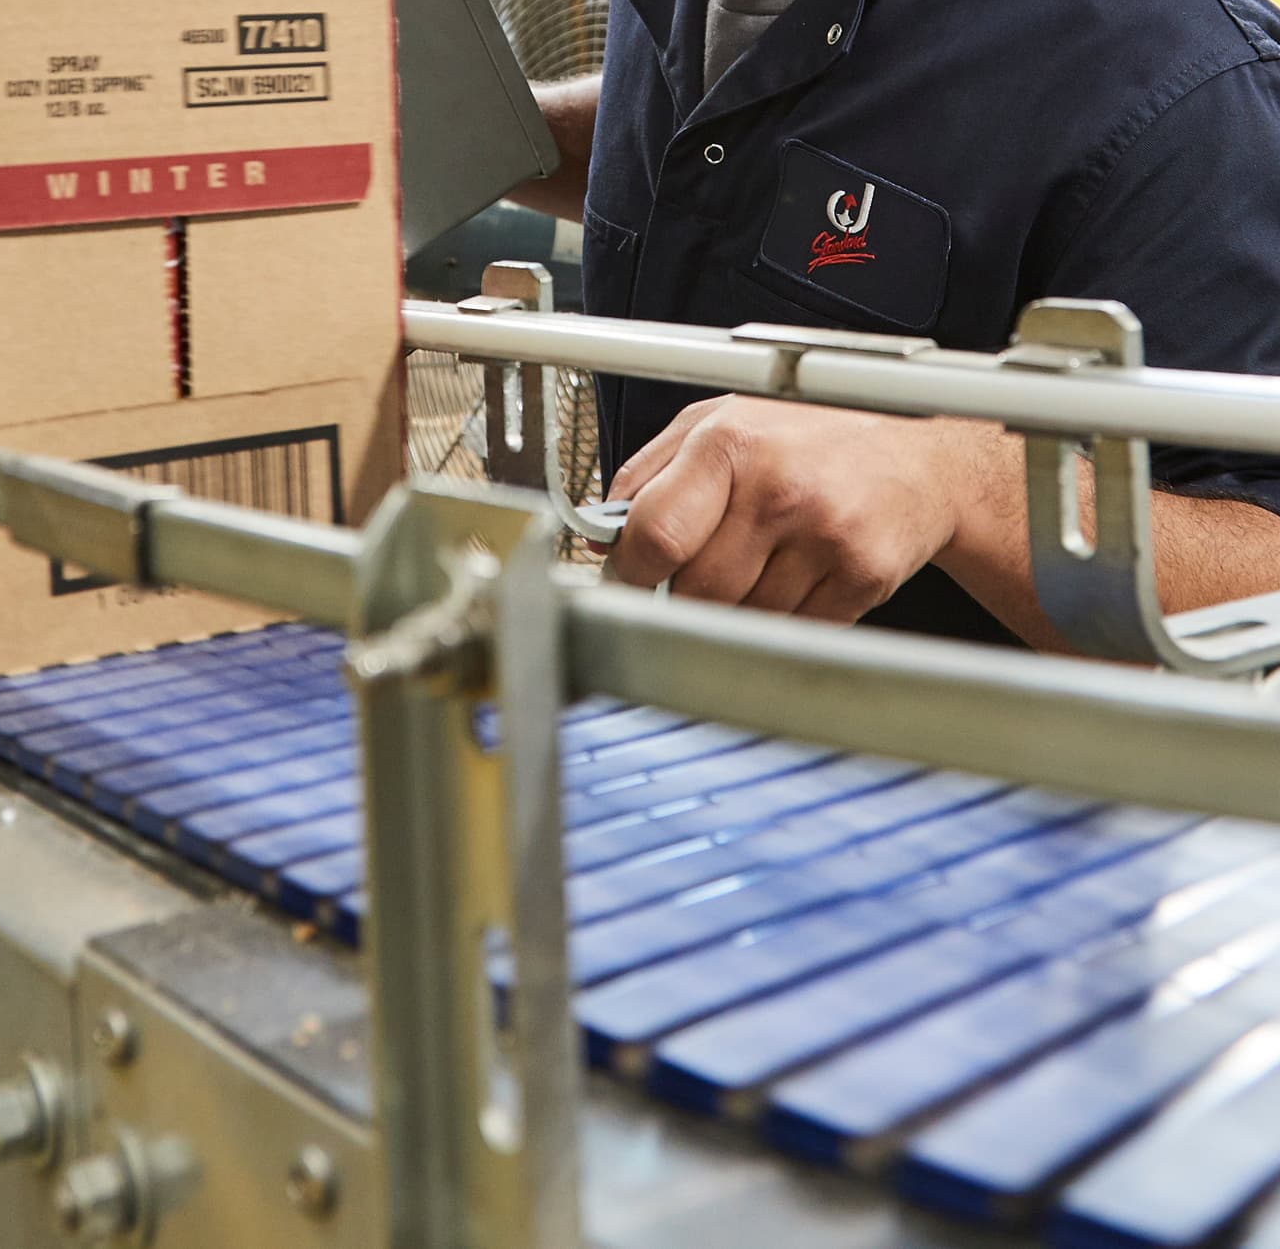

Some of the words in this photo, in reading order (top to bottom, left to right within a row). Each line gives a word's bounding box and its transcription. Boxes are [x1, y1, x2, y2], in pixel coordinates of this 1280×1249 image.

[240, 18, 321, 50] 77410
[47, 56, 101, 73] SPRAY
[6, 80, 42, 98] COZY
[47, 78, 86, 96] CIDER
[45, 160, 267, 199] WINTER
